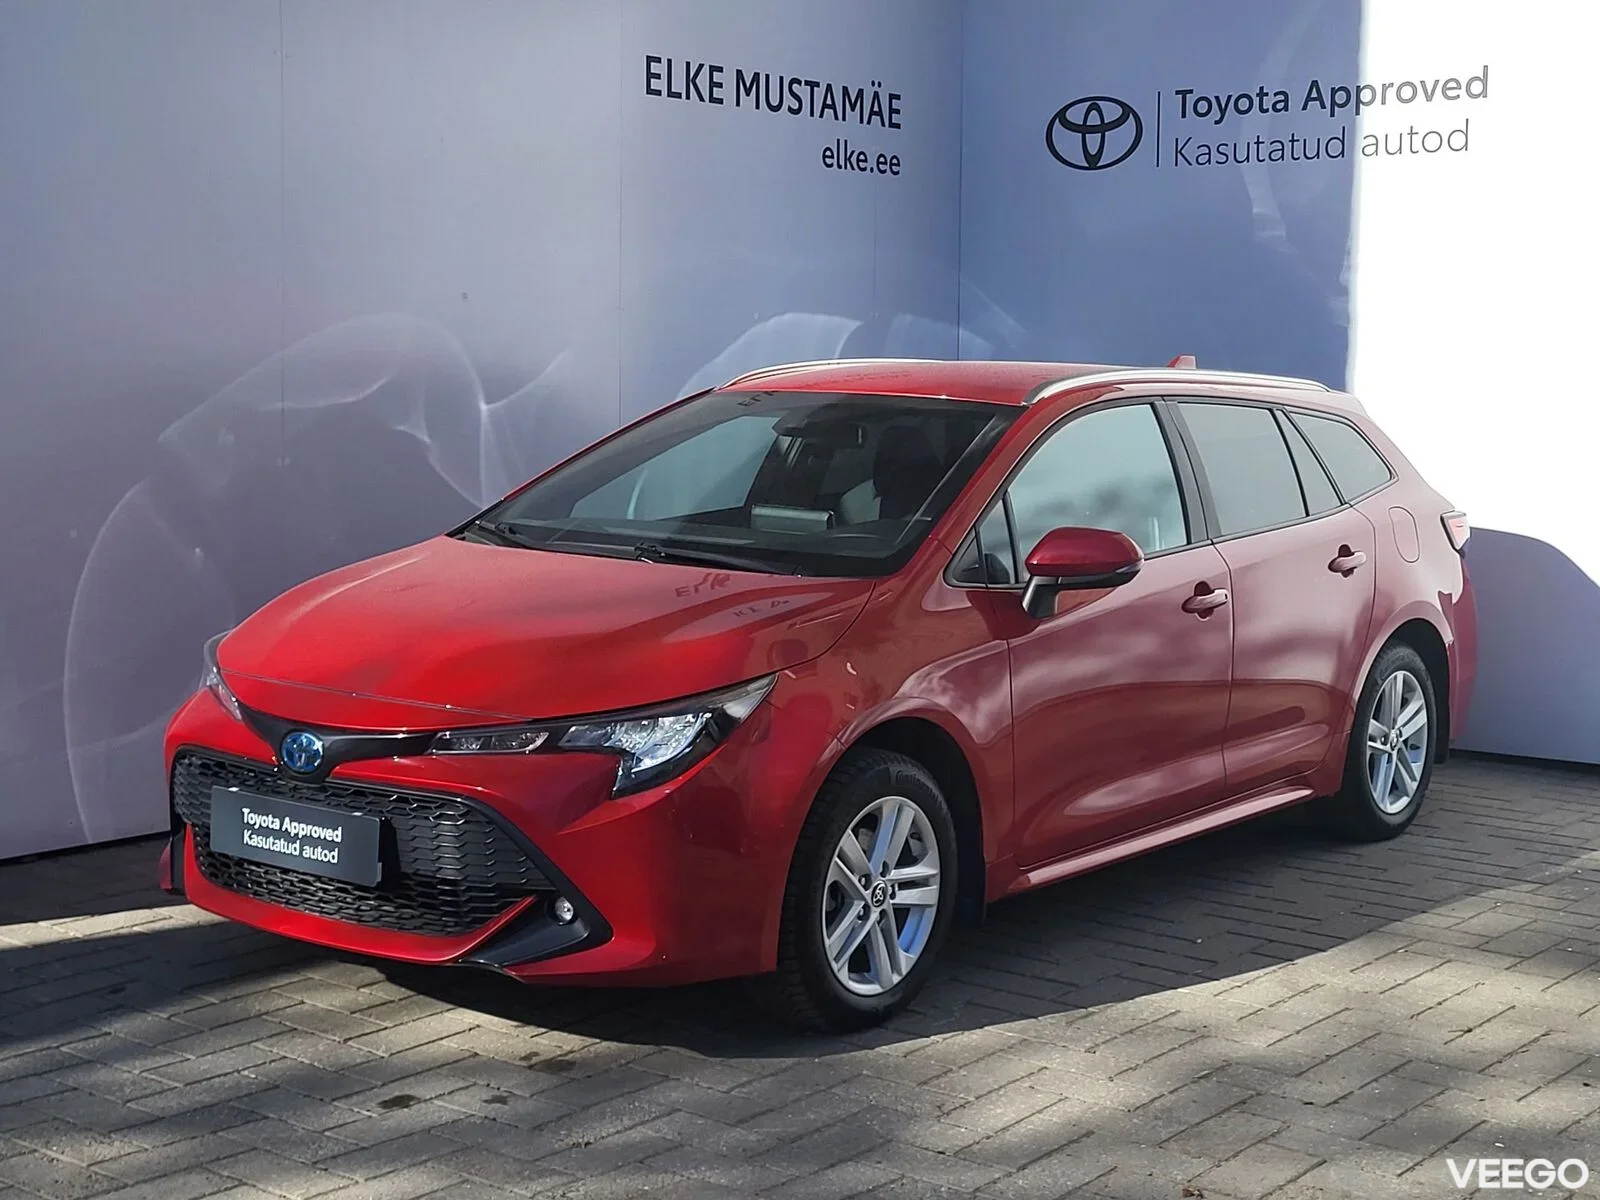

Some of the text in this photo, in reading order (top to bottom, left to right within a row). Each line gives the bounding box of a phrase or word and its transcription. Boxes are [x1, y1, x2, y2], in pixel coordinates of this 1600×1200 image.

[645, 54, 902, 130] ELKE MUSTAMÄE
[1174, 65, 1489, 125] Toyota Approved
[821, 138, 901, 176] elke.ee
[1174, 118, 1470, 168] Kasutatud autod
[241, 808, 342, 843] Toyota Approved
[243, 829, 338, 864] Kasutatud autod
